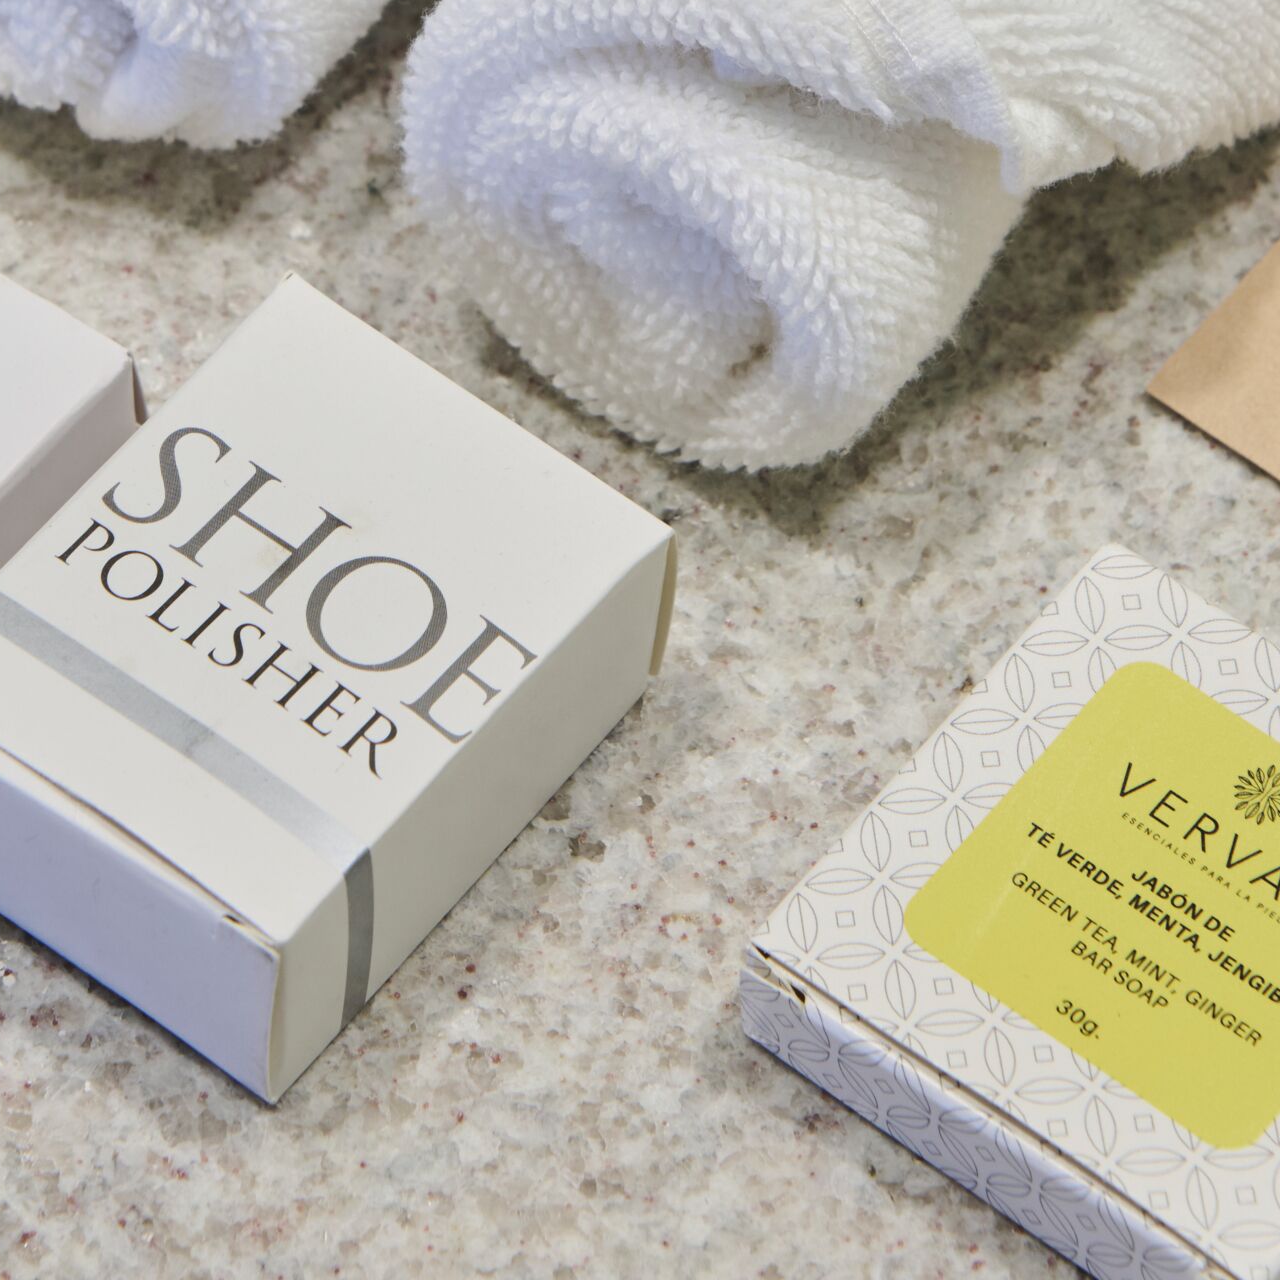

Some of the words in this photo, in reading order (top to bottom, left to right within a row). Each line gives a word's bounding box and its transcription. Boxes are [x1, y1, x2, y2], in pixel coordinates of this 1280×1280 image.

[102, 427, 538, 744] SHOE
[54, 518, 399, 780] POLISHER
[1027, 822, 1055, 848] TÉ
[1056, 843, 1125, 900] VERDE,
[1128, 894, 1201, 953] MENTA,
[1121, 811, 1196, 866] ESENCIALES
[1200, 865, 1231, 889] PARA
[1236, 889, 1251, 903] LA
[1131, 870, 1204, 921] JABÓN
[1203, 916, 1236, 943] DE
[1011, 872, 1079, 922] GREEN
[1081, 917, 1121, 955] TEA,
[1125, 949, 1181, 995] MINT,
[1185, 989, 1263, 1047] GINGER
[1071, 941, 1113, 975] BAR
[1113, 970, 1169, 1010] SOAP
[1055, 999, 1101, 1040] 30g.
